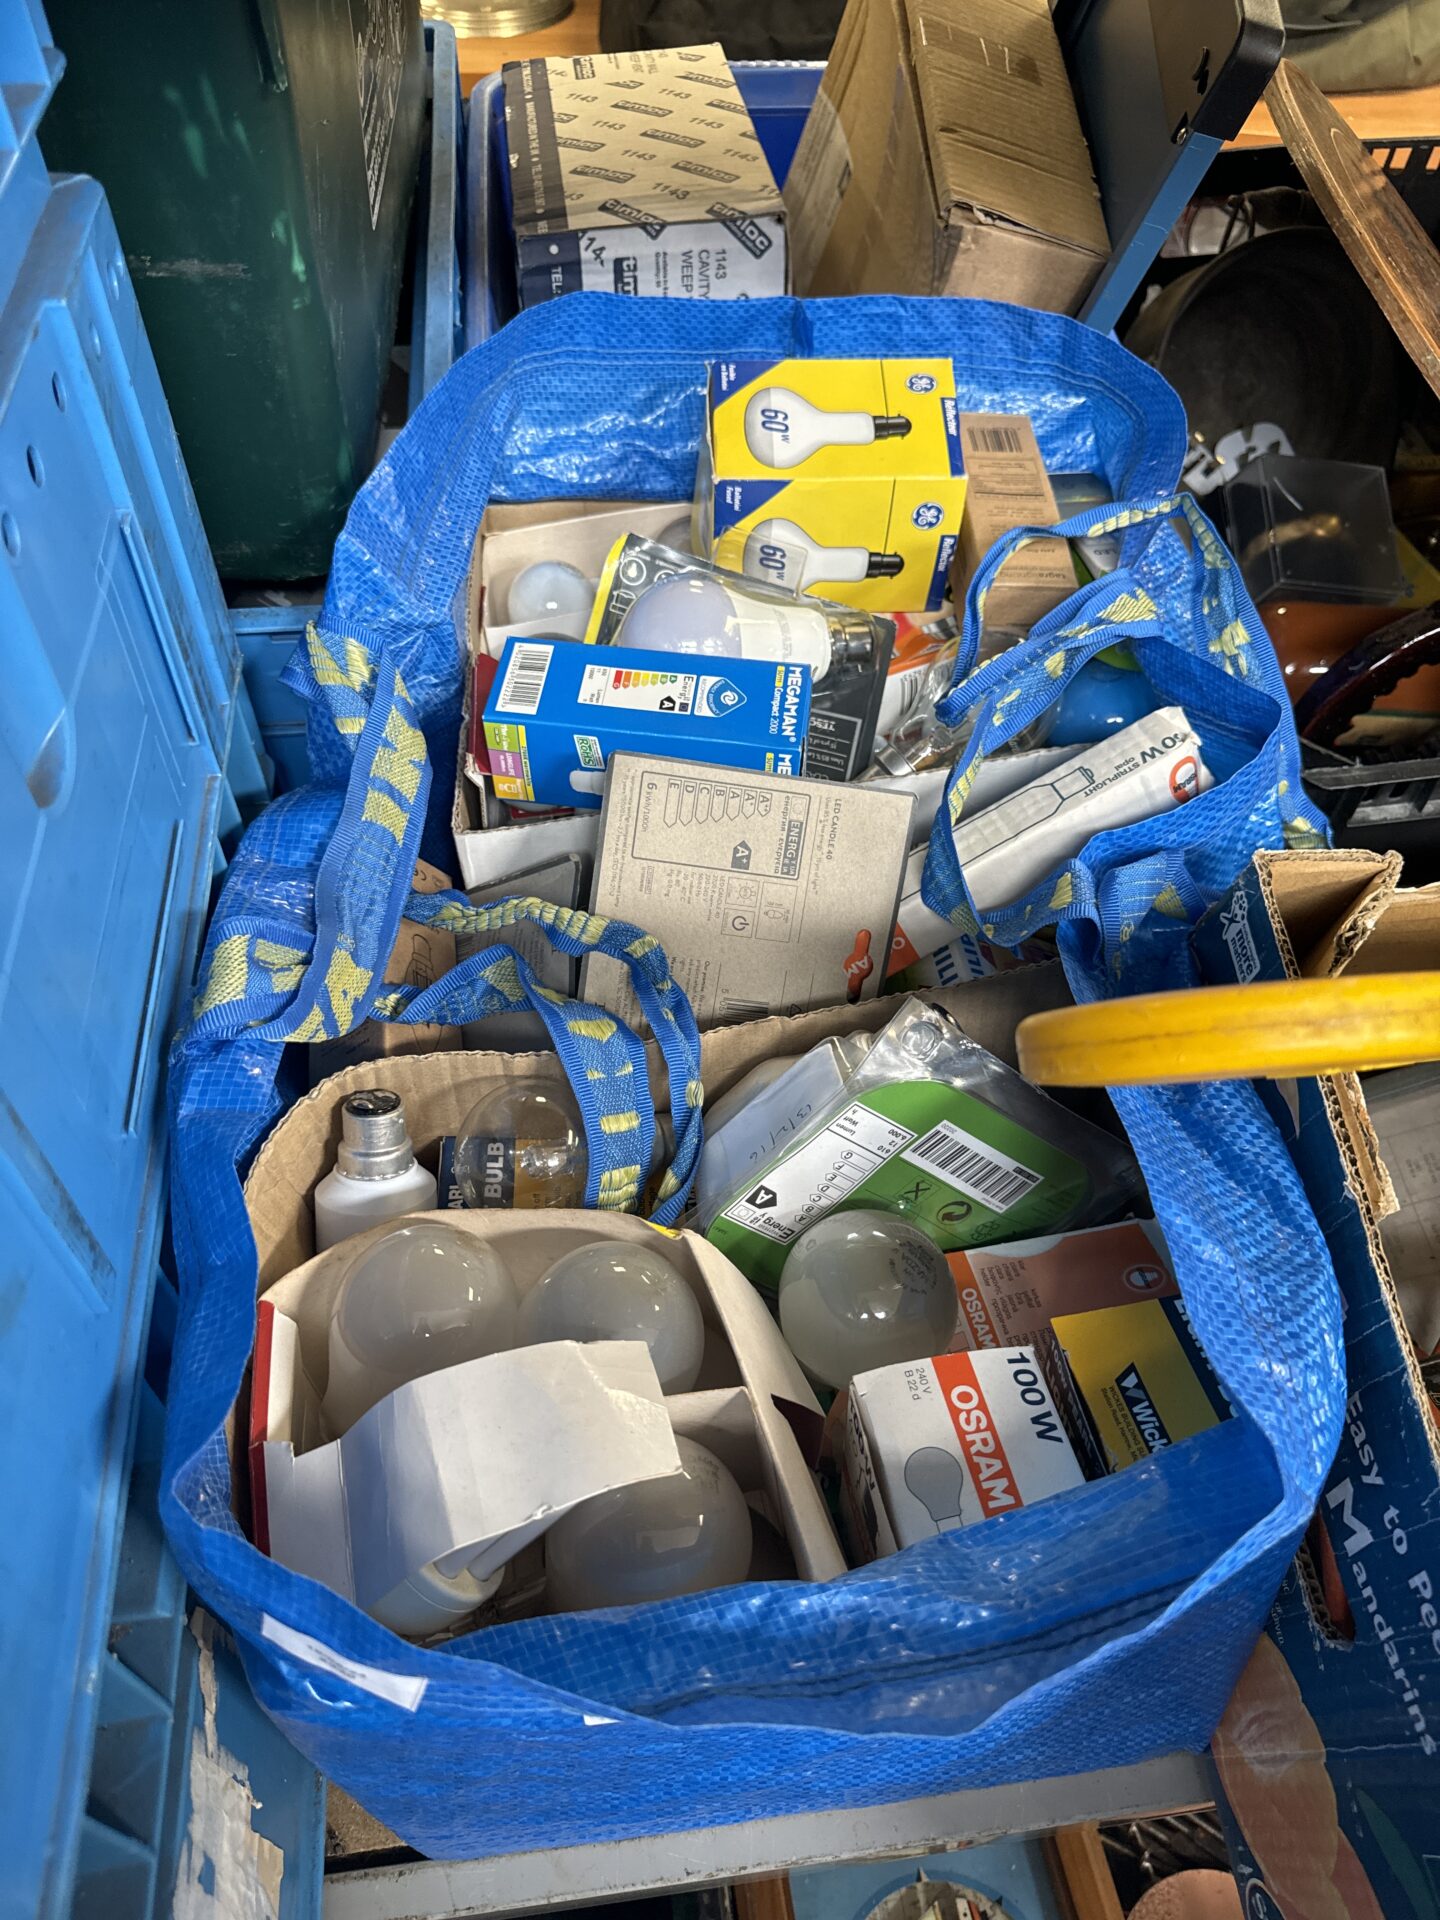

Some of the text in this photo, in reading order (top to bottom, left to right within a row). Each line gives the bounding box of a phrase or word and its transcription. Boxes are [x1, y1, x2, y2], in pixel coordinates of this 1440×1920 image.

[592, 120, 626, 131] 1143
[689, 117, 724, 130] 1143
[621, 149, 656, 161] 1143
[722, 148, 760, 163] 1143
[652, 183, 691, 200] 1143
[681, 250, 693, 291] WEEP
[715, 249, 727, 280] 1143
[551, 267, 563, 294] TEL:
[661, 700, 673, 709] A
[768, 687, 783, 734] Compact 2000
[1114, 756, 1136, 771] opal
[1083, 762, 1140, 797] STRIPLIGHT
[684, 784, 695, 793] D
[699, 786, 710, 794] C
[714, 788, 725, 796] B
[729, 790, 740, 799] A
[832, 797, 843, 815] LED
[786, 821, 800, 857] ENERG
[826, 814, 840, 848] CANDLE
[1236, 923, 1253, 976] more
[843, 1116, 859, 1126] Watt
[836, 1122, 891, 1154] 610 Lumen
[888, 1128, 907, 1140] 6.000
[484, 1141, 505, 1198] BULB
[836, 1163, 845, 1171] F
[828, 1173, 838, 1182] E
[755, 1190, 773, 1205] A
[962, 1287, 998, 1348] OSRAM
[916, 1368, 929, 1385] 240
[908, 1379, 918, 1393] 22
[1006, 1352, 1046, 1406] 100
[1030, 1410, 1064, 1443] W
[1109, 1386, 1123, 1413] WICKES
[1120, 1413, 1140, 1445] BUILDING
[951, 1385, 1016, 1509] OSRAM
[1381, 1504, 1410, 1555] to
[1325, 1476, 1438, 1757] Mandarins
